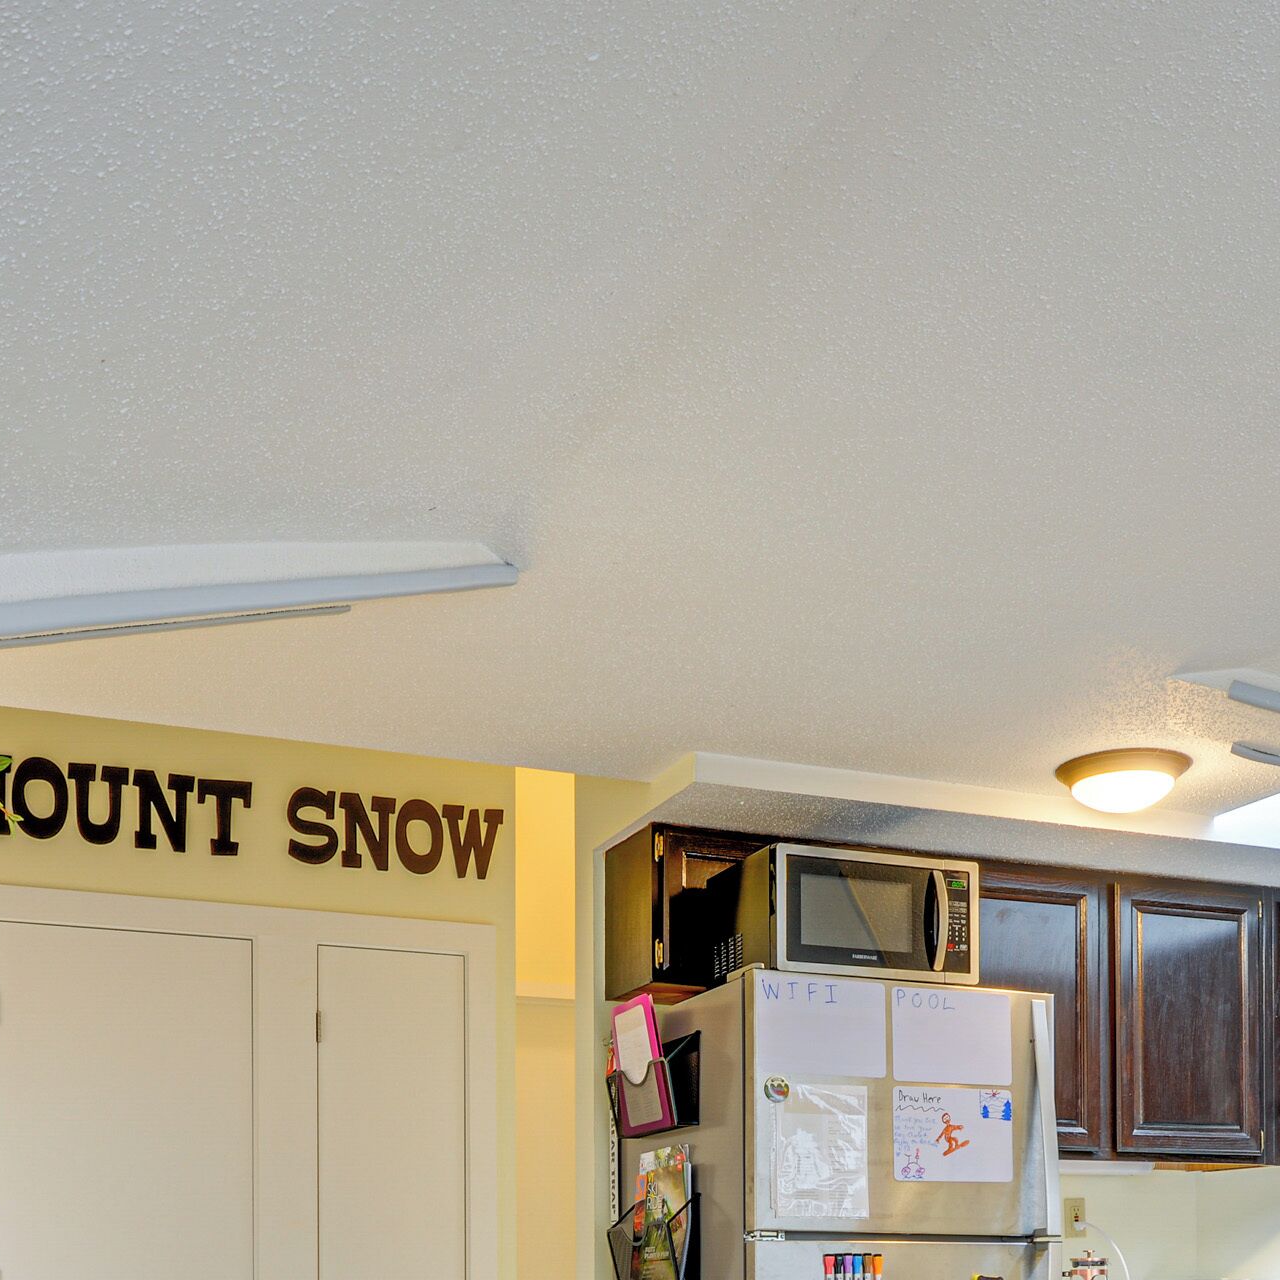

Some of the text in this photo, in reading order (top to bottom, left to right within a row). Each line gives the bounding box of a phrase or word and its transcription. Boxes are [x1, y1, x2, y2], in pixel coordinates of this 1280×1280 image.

[287, 786, 504, 880] SNOW
[761, 979, 838, 1004] WIFI
[896, 988, 955, 1010] POOL
[899, 1090, 941, 1103] Draw Here
